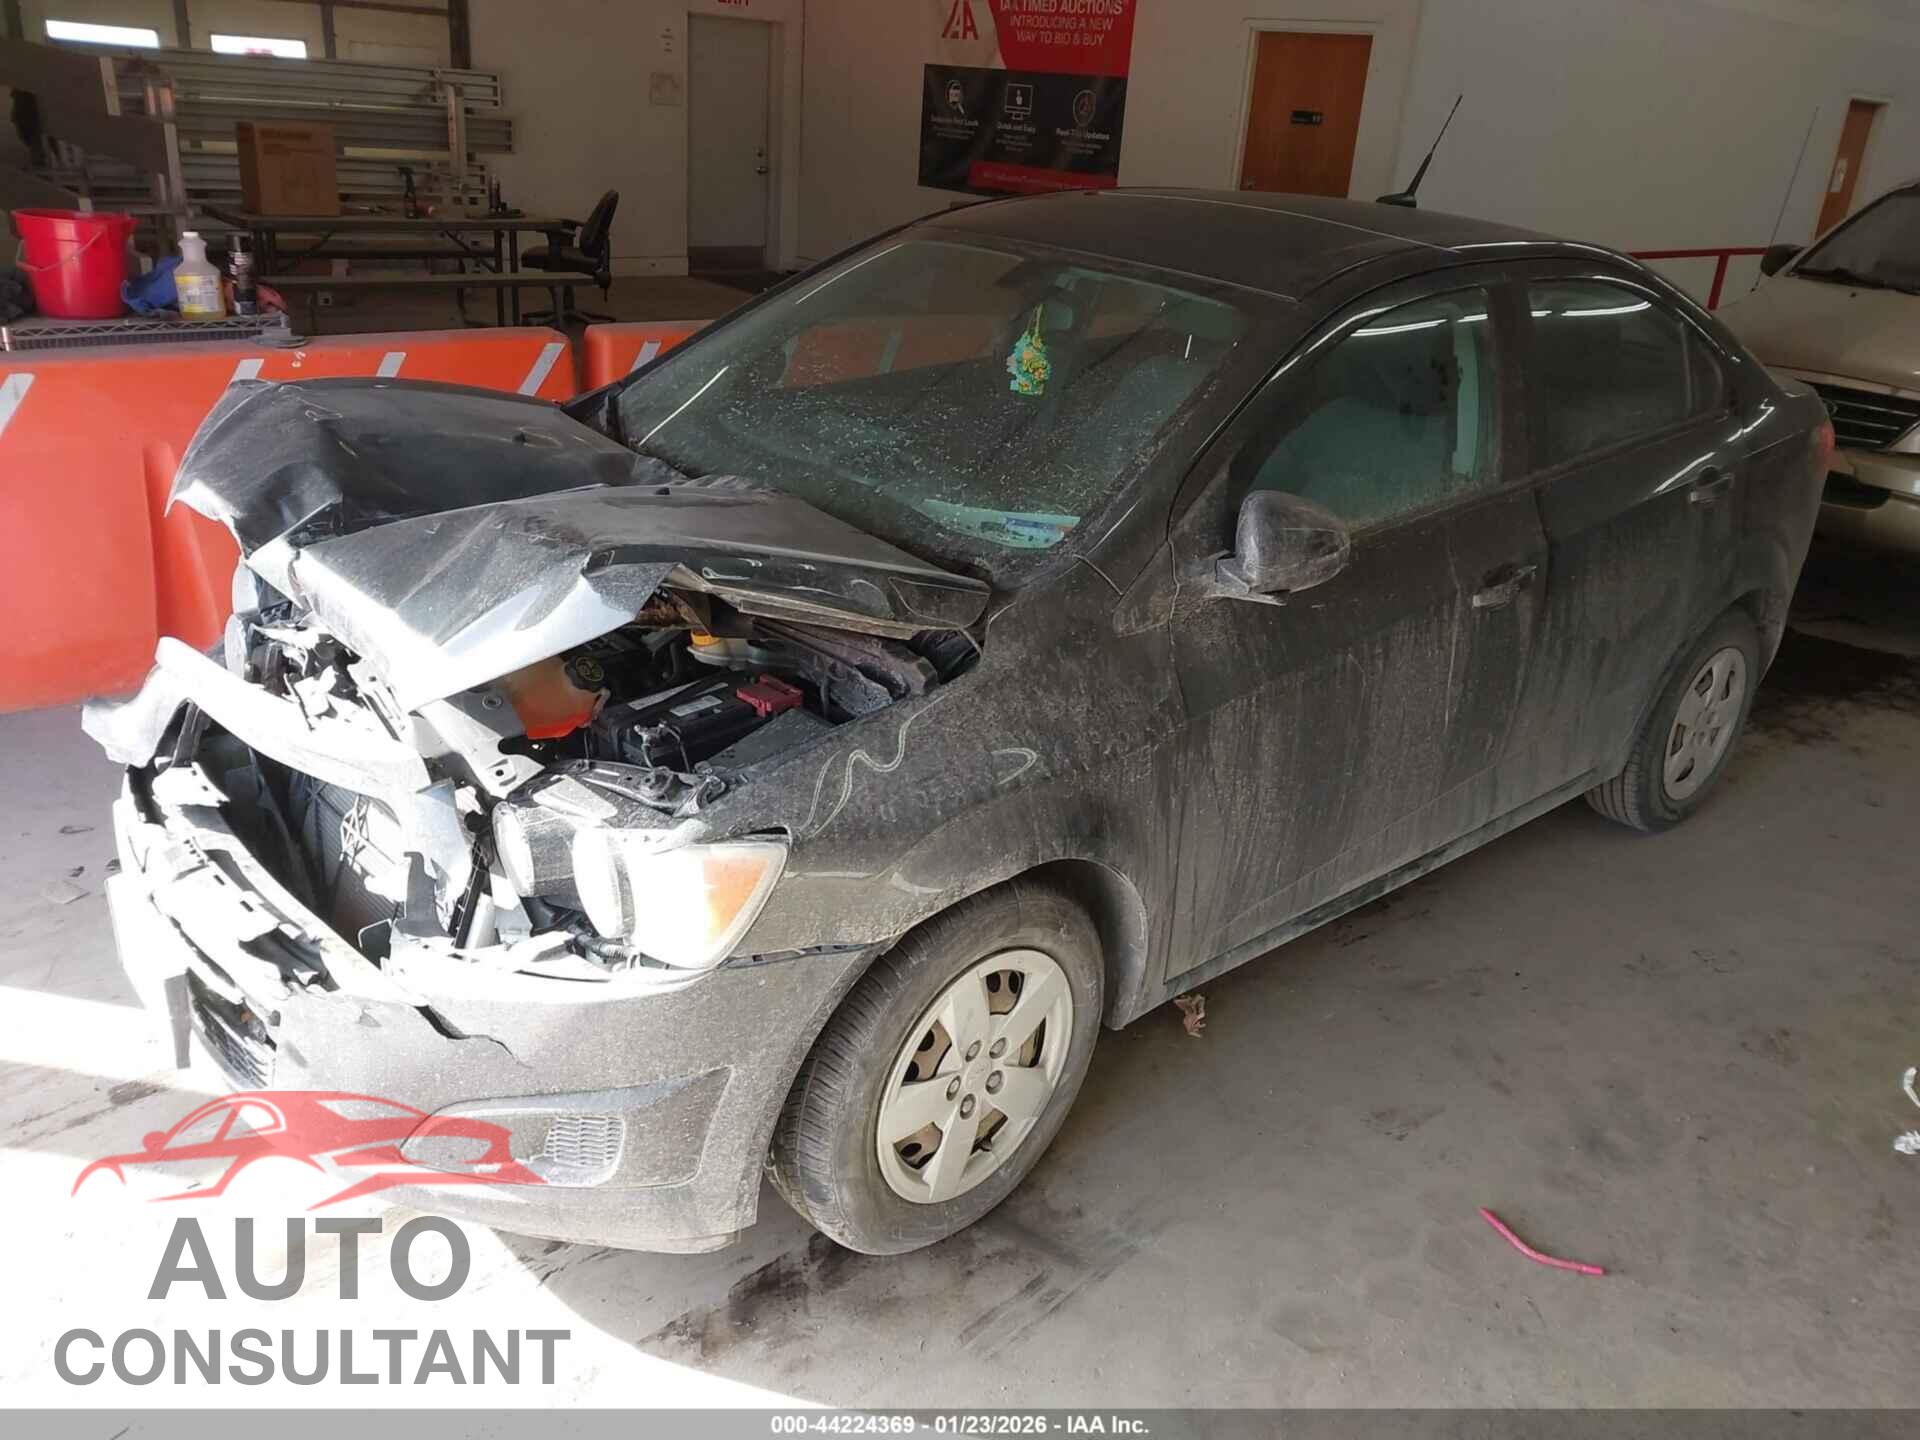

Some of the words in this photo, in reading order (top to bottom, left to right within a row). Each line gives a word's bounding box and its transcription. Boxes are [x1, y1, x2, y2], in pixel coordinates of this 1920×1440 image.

[1022, 0, 1058, 12] TIMED
[1060, 0, 1123, 15] AUCTIONS
[1010, 15, 1077, 30] INTRODUCING
[1079, 17, 1086, 30] A
[1089, 17, 1113, 31] NEW
[1016, 30, 1037, 43] WAY
[1038, 32, 1054, 44] TO
[1083, 33, 1104, 47] BUY
